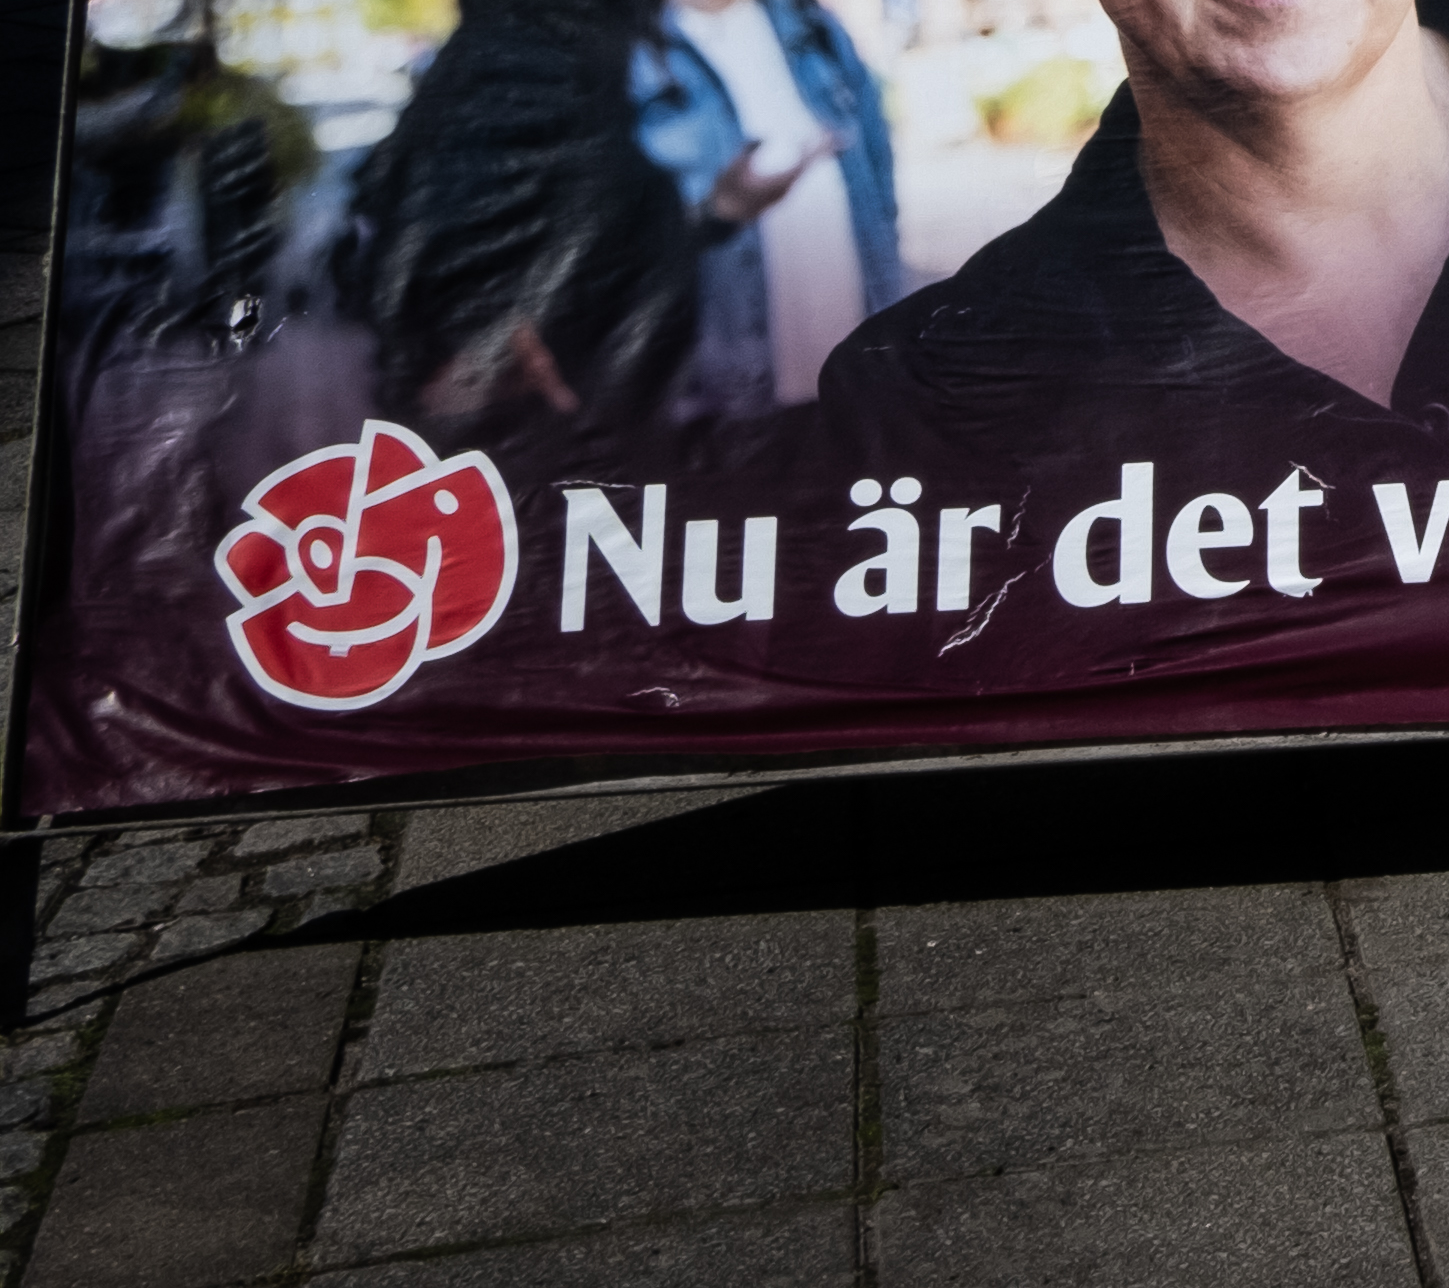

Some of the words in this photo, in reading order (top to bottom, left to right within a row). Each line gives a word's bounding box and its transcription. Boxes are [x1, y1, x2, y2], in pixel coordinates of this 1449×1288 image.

[560, 482, 779, 633] Nu
[832, 475, 1002, 618] är
[1052, 461, 1325, 608] det
